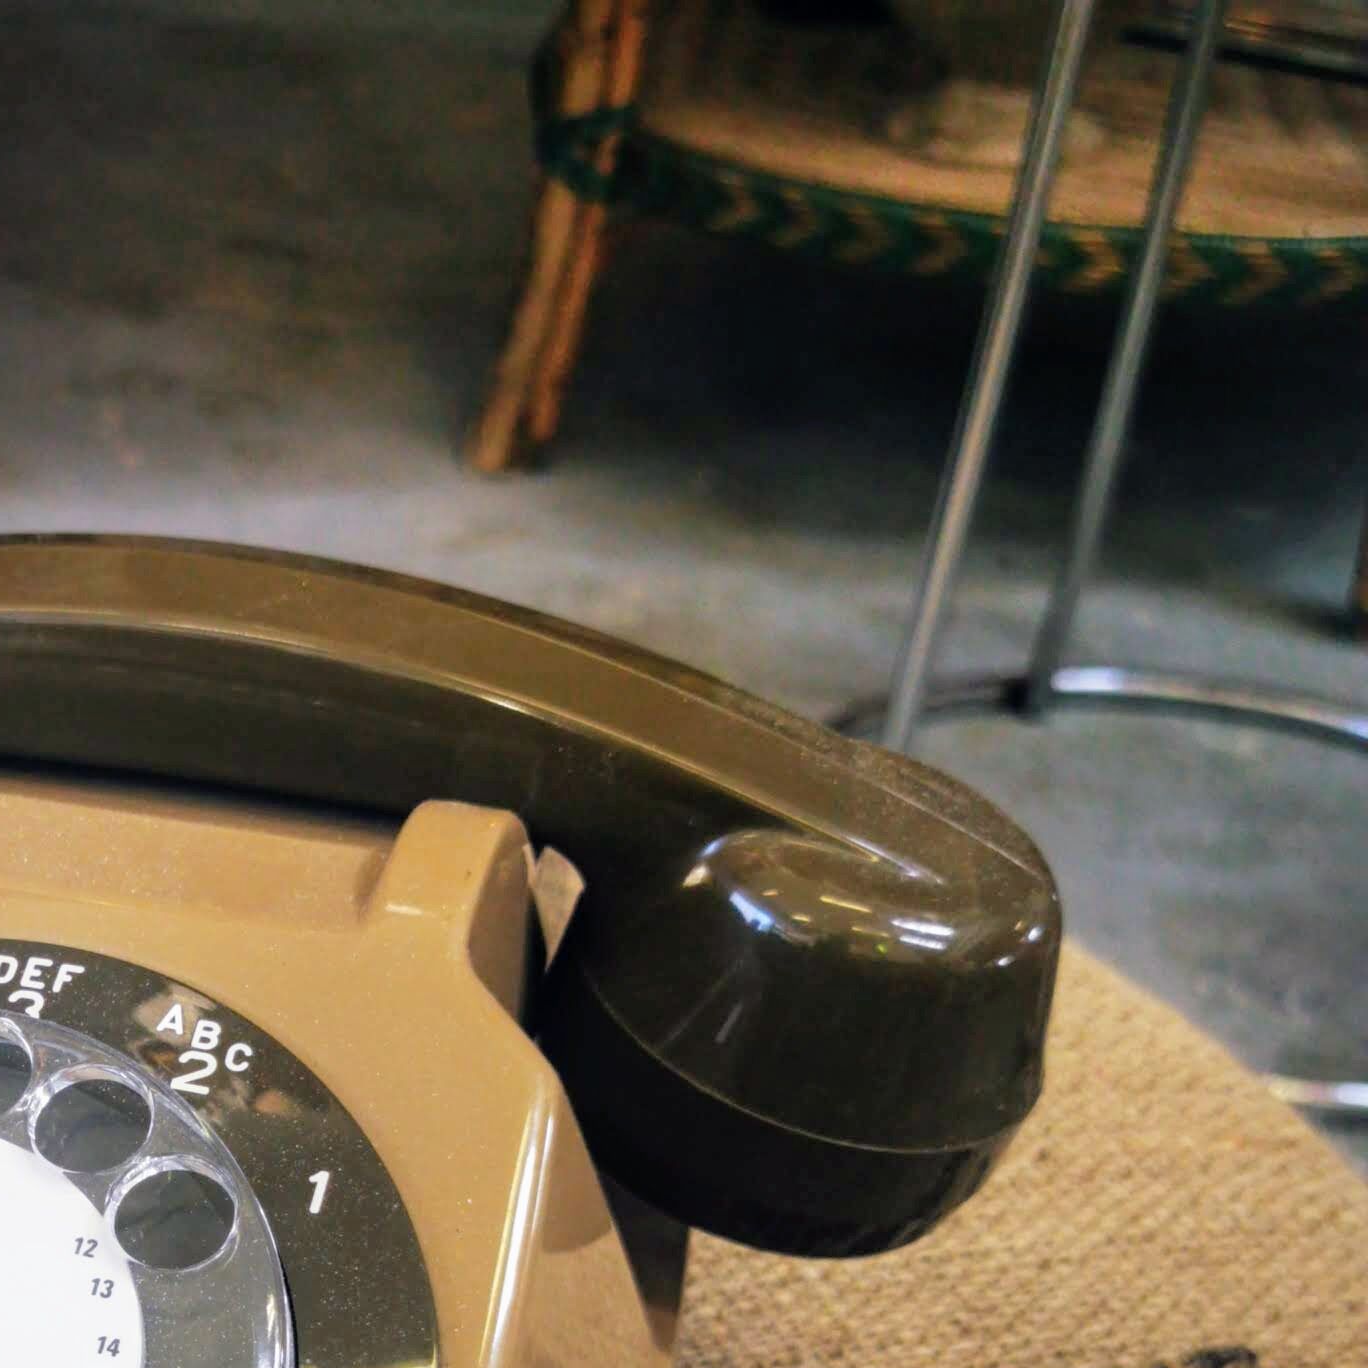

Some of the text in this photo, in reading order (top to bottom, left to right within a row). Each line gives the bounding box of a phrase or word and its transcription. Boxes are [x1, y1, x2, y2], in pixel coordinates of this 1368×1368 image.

[155, 1002, 254, 1073] ABC
[169, 1049, 218, 1096] 2
[307, 1169, 330, 1215] 1
[72, 1236, 99, 1260] 12
[89, 1276, 115, 1300] 13
[95, 1334, 122, 1358] 14
